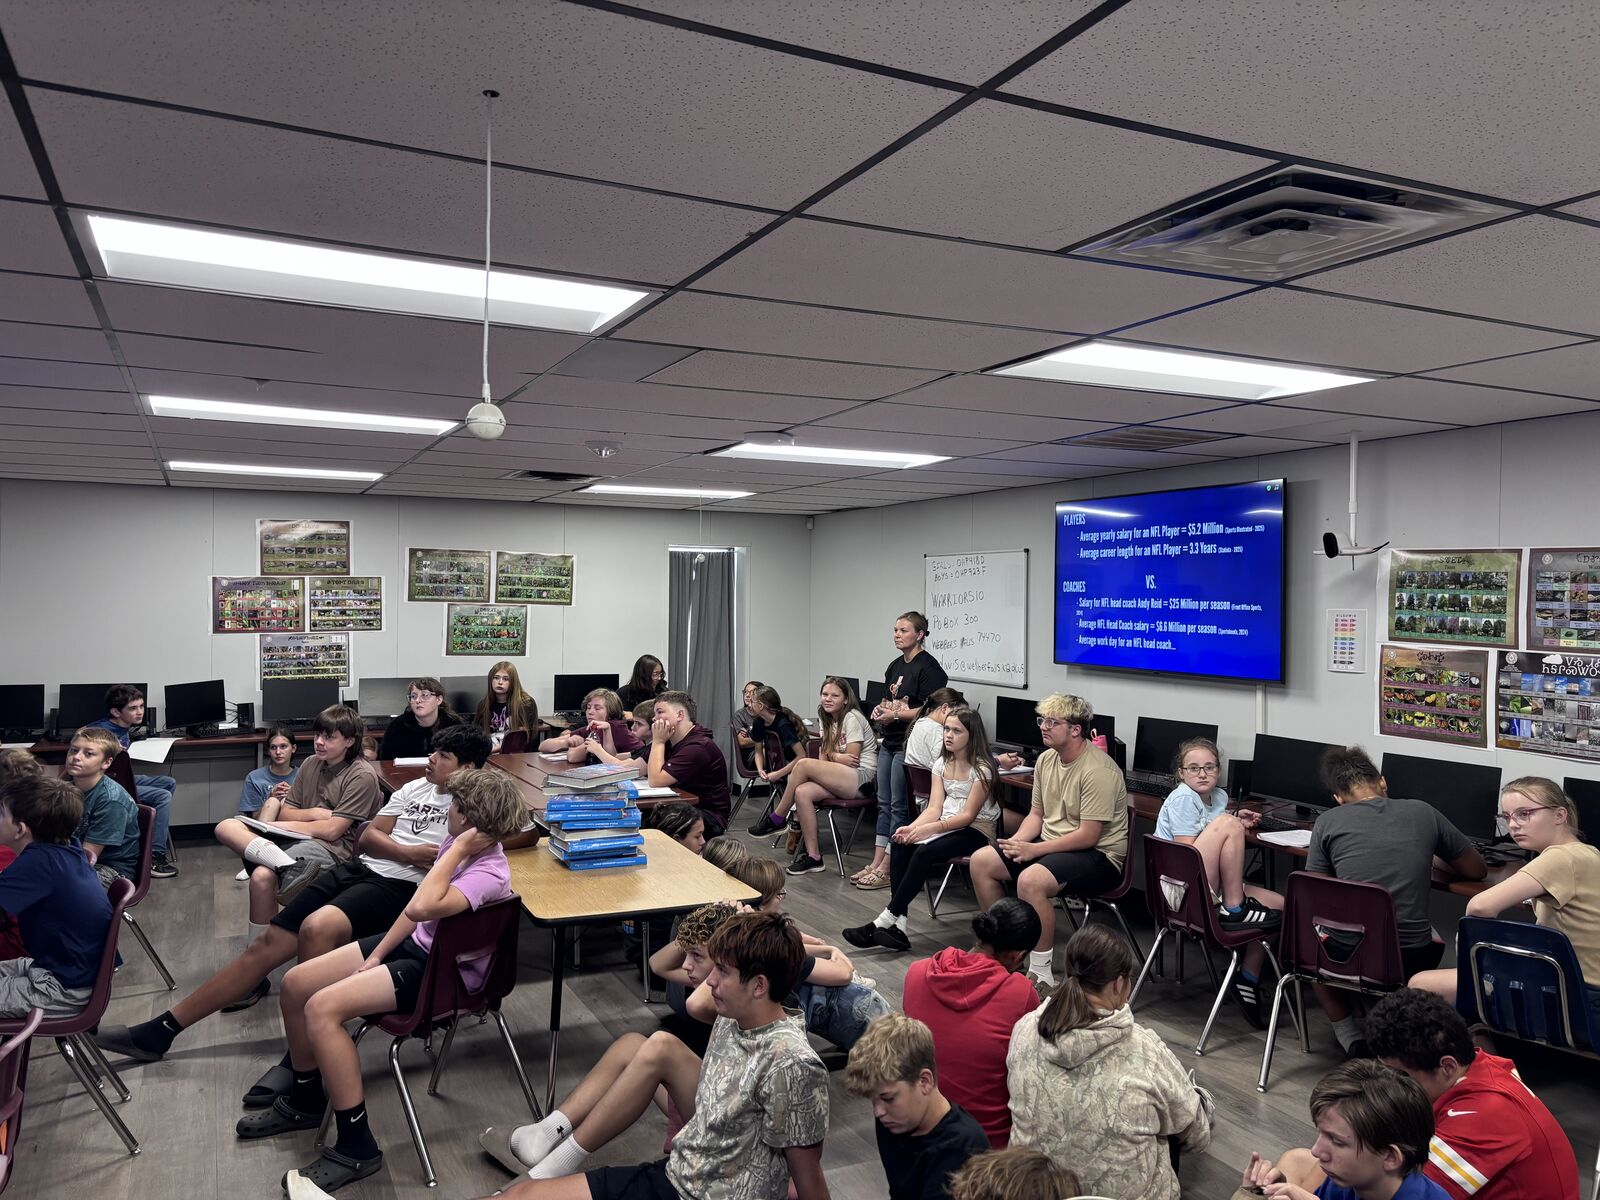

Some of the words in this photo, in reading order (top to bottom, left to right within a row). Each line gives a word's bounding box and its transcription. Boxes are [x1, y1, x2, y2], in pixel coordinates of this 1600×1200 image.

[1064, 514, 1086, 526] PLAYERS
[1080, 531, 1099, 543] Average
[1100, 529, 1116, 542] yearly
[1116, 528, 1132, 541] salary
[1142, 529, 1149, 538] an
[1151, 526, 1160, 537] NFL
[1162, 525, 1180, 539] Player
[1188, 523, 1201, 536] $5.2
[1203, 522, 1223, 534] Million
[1080, 548, 1099, 560] Average
[1100, 548, 1116, 558] career
[1117, 545, 1133, 559] length
[1135, 545, 1143, 556] for
[1144, 547, 1150, 556] an
[1152, 544, 1162, 555] NFL
[1163, 544, 1181, 557] Player
[1190, 542, 1199, 554] 3.3
[1200, 542, 1217, 553] Years
[1063, 581, 1086, 592] COACHES
[1145, 575, 1156, 589] VS.
[1079, 598, 1093, 609] Salary
[1101, 598, 1109, 607] NFL
[1110, 598, 1121, 608] head
[1122, 598, 1136, 608] coach
[1138, 598, 1150, 610] Andy
[1151, 598, 1162, 608] Reid
[1169, 598, 1180, 610] $25
[1180, 598, 1198, 609] Million
[1200, 601, 1209, 612] per
[1210, 601, 1230, 610] season
[964, 613, 978, 626] 300
[1079, 619, 1096, 630] Average
[1097, 619, 1105, 628] NFL
[1107, 620, 1118, 629] Head
[1119, 620, 1133, 630] Coach
[1134, 621, 1149, 633] salary
[1156, 621, 1167, 632] $6.6
[1168, 622, 1186, 632] Million
[1187, 625, 1197, 635] per
[1198, 625, 1217, 634] season
[977, 632, 1001, 643] 74470
[1079, 635, 1096, 647] Average
[1097, 636, 1108, 646] work
[1109, 636, 1117, 648] day
[1133, 638, 1142, 648] NFL
[1144, 638, 1155, 649] head
